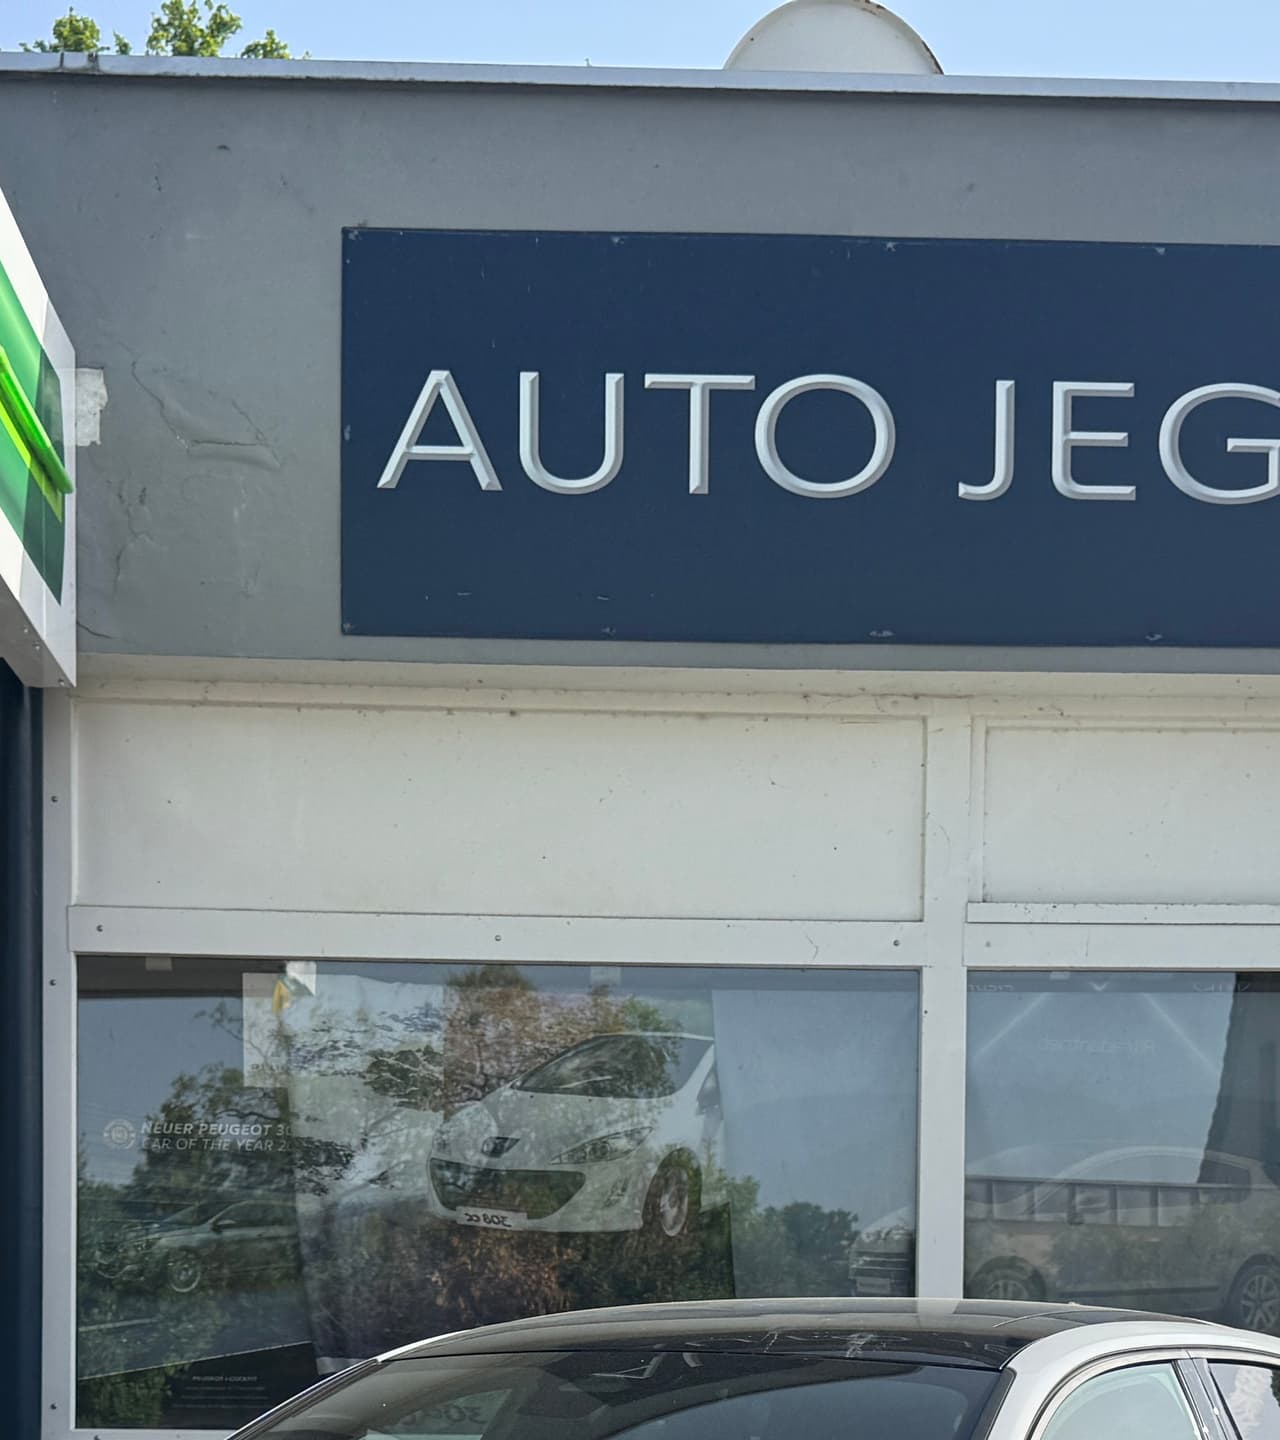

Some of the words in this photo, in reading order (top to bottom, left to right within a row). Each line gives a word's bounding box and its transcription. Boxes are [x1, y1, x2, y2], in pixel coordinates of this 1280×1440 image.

[376, 369, 897, 499] AUTO
[140, 1121, 193, 1136] NEUER
[198, 1122, 272, 1137] PEUGEOT
[141, 1137, 171, 1151] CAR
[175, 1137, 198, 1151] OF
[201, 1138, 231, 1151] THE
[236, 1138, 273, 1152] YEAR
